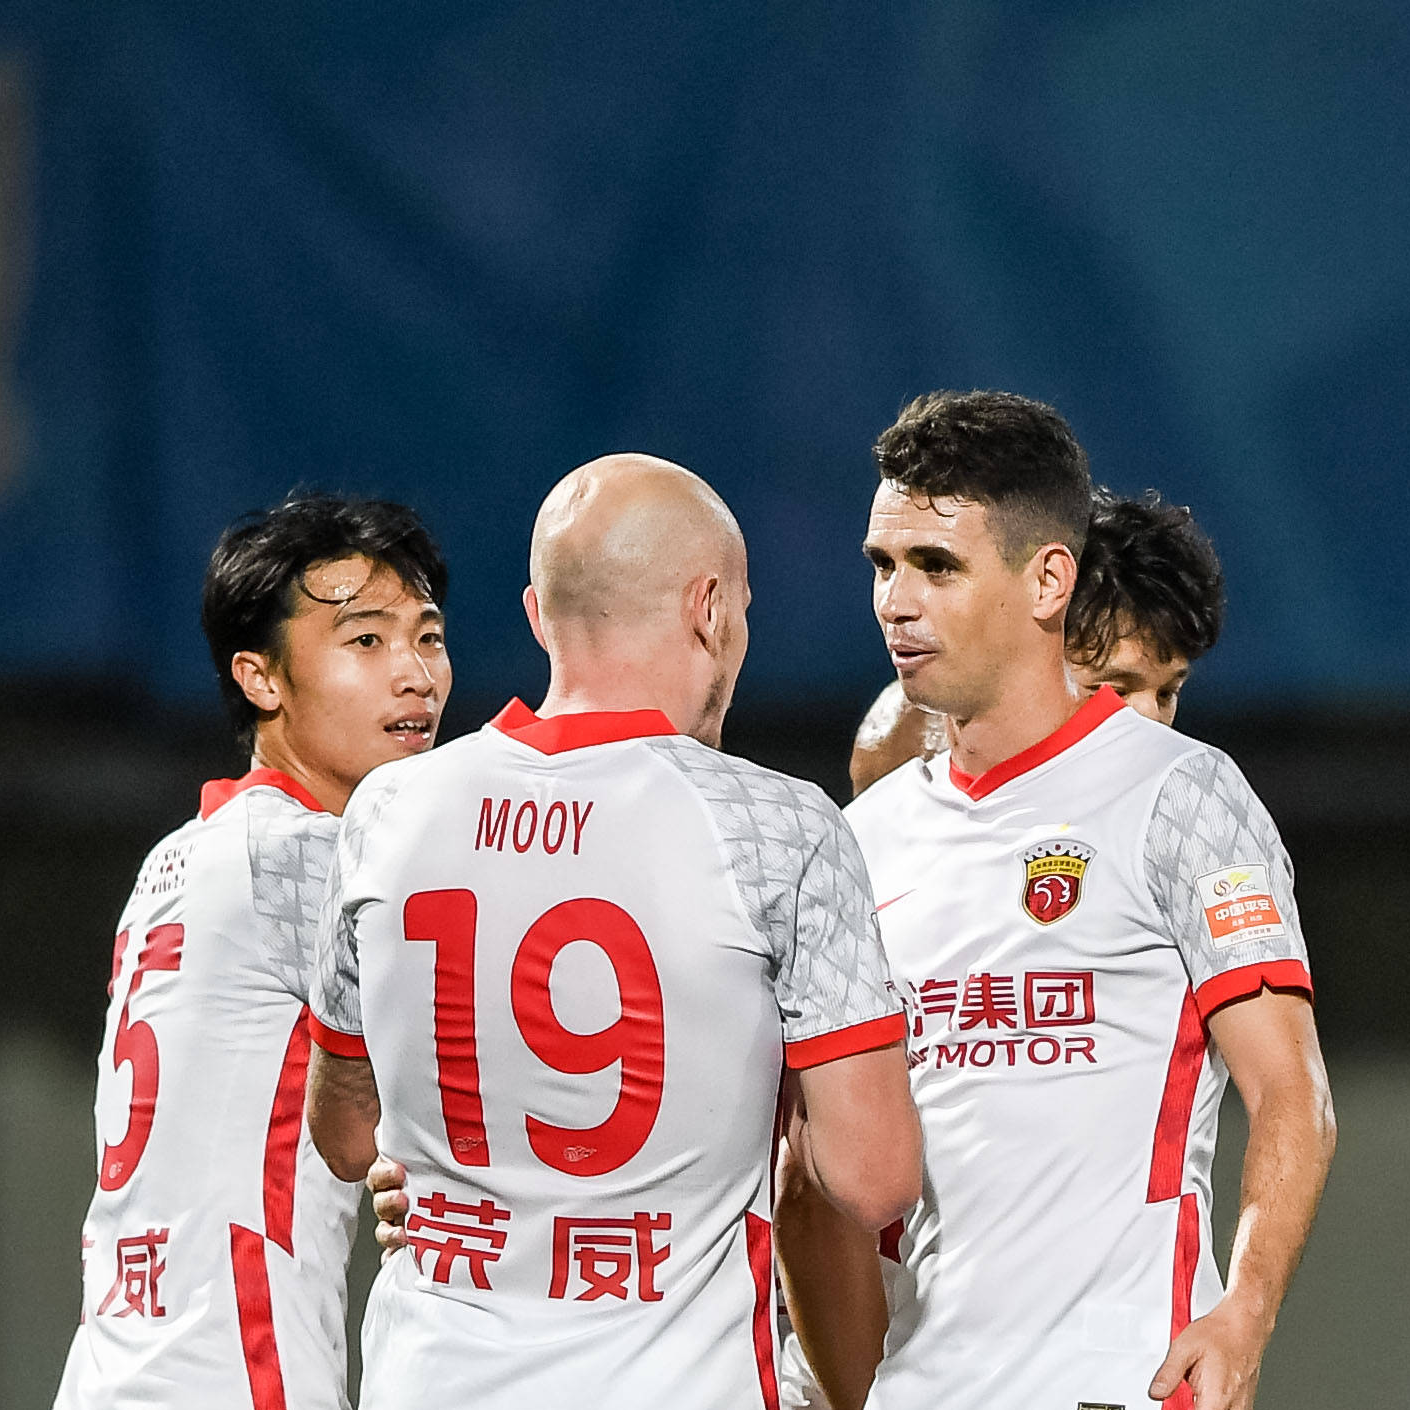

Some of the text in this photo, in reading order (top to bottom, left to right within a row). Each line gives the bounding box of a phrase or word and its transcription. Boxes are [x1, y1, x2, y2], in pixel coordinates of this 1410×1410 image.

[475, 797, 594, 855] MOOY
[403, 888, 665, 1178] 19
[901, 972, 1096, 1038] 汽集团
[100, 922, 185, 1192] 5
[935, 1036, 1097, 1070] MOTOR
[81, 1226, 171, 1319] 威
[406, 1191, 673, 1303] 荣威
